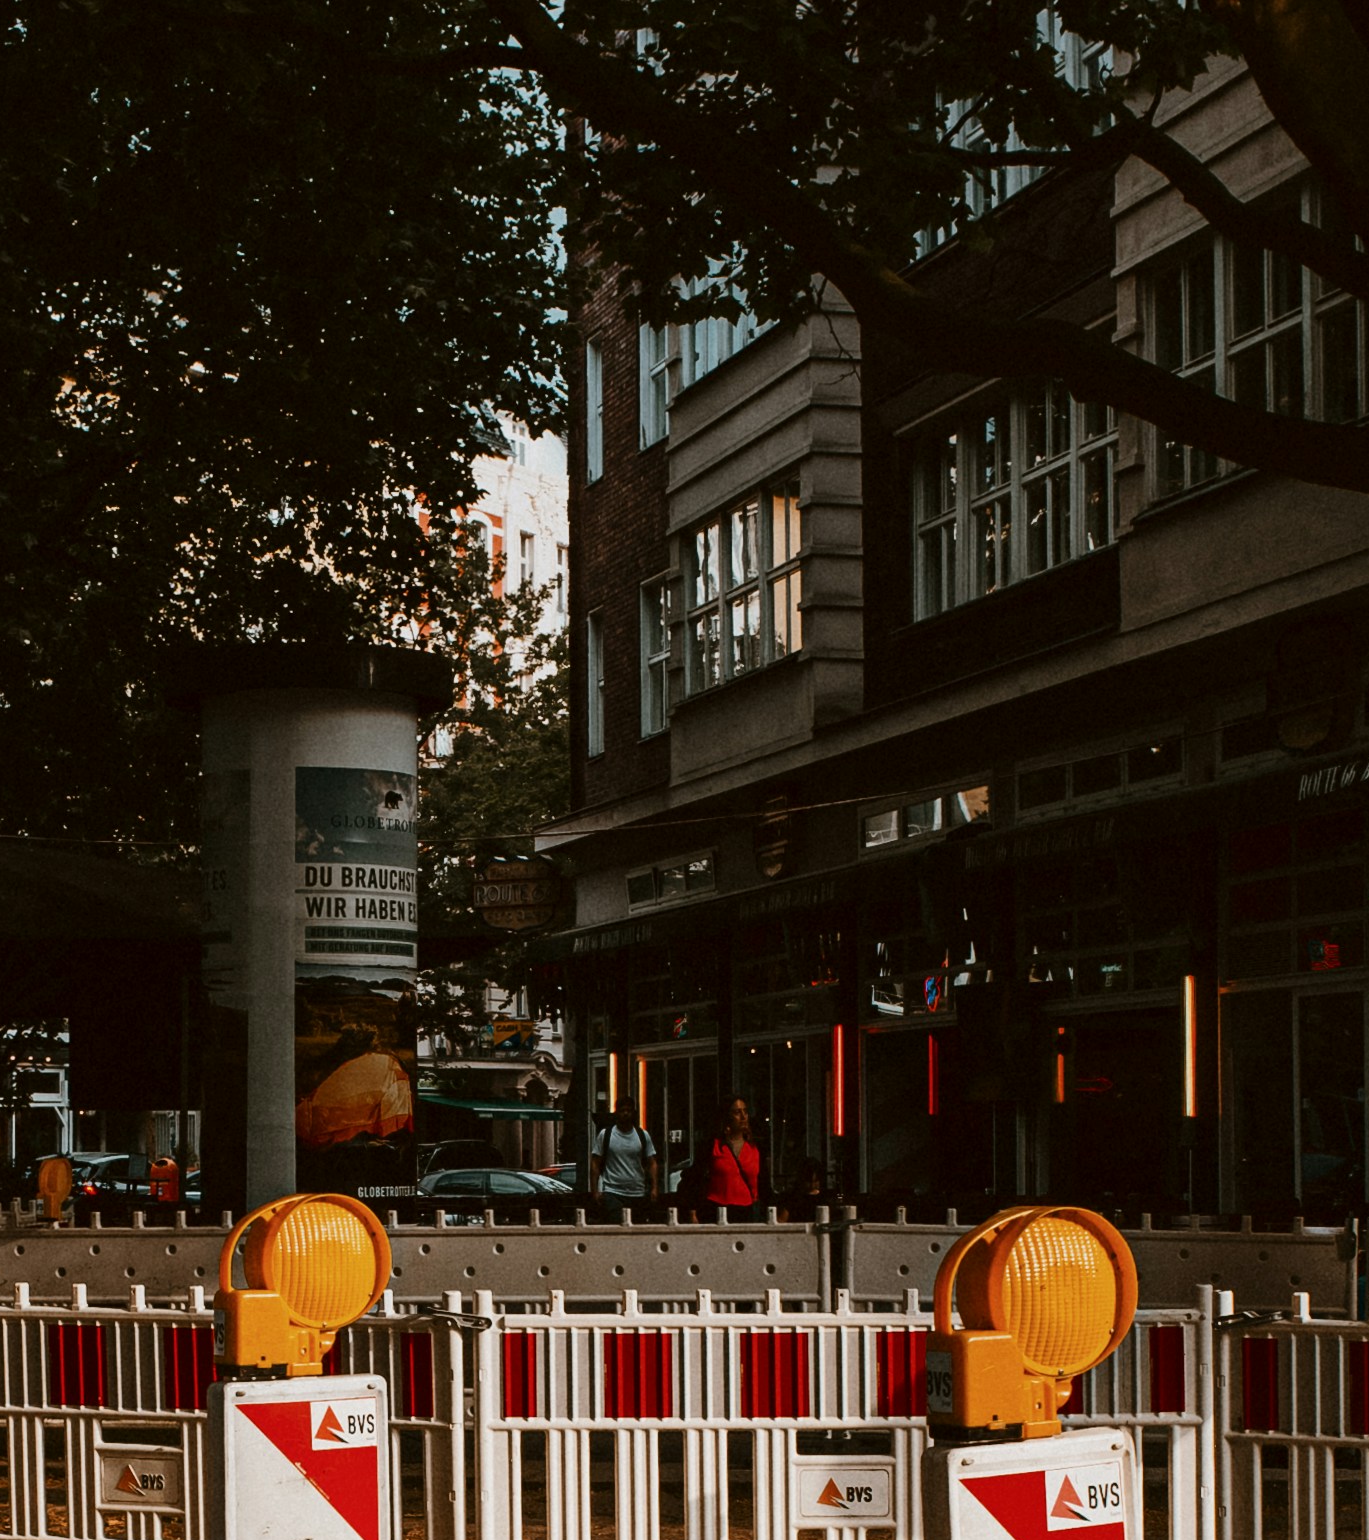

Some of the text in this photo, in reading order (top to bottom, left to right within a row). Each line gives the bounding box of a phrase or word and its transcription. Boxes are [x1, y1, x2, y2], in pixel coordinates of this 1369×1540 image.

[1298, 764, 1342, 801] ROUTE
[305, 866, 333, 887] DU
[305, 897, 346, 918] WIR
[355, 898, 405, 921] HABEN
[347, 1414, 375, 1435] BVS
[141, 1473, 164, 1490] BVS
[846, 1486, 873, 1503] BVS
[1088, 1482, 1121, 1509] BVS
